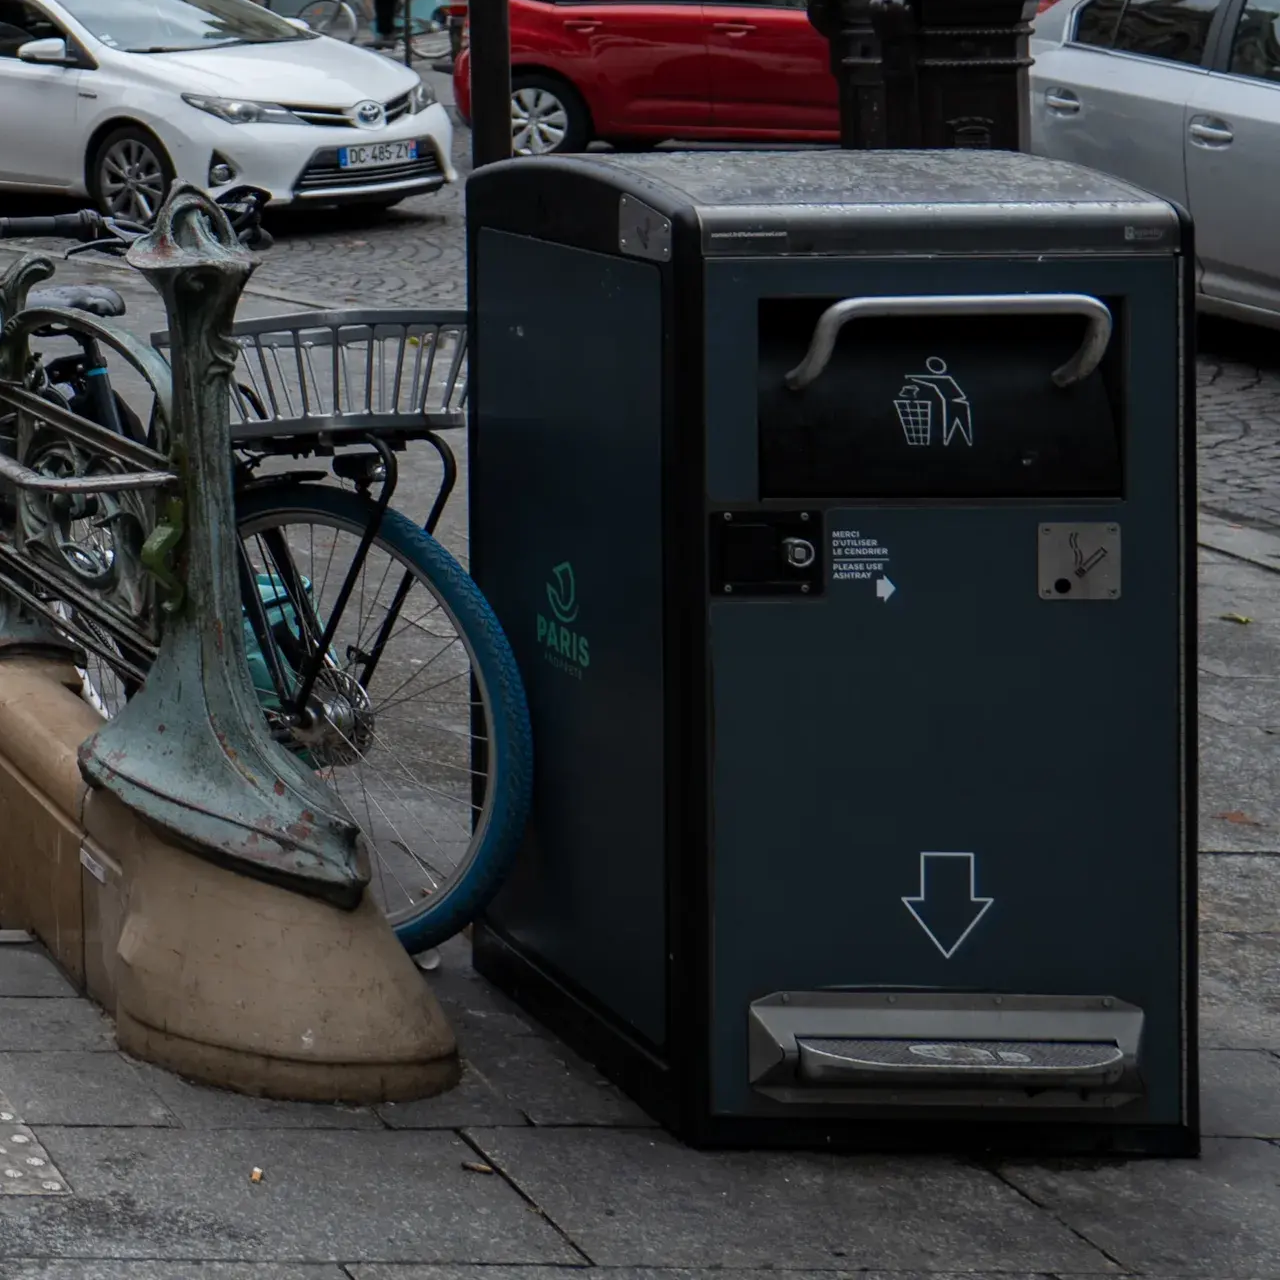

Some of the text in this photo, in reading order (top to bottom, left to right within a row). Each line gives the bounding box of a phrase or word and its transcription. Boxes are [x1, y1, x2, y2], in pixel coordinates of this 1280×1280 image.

[832, 530, 860, 538] MERCI
[832, 539, 878, 547] D'UTILISER
[832, 547, 889, 556] LE CENDRIER
[832, 563, 865, 571] PLEASE
[832, 571, 872, 580] ASHTRAY
[537, 612, 590, 668] PARIS
